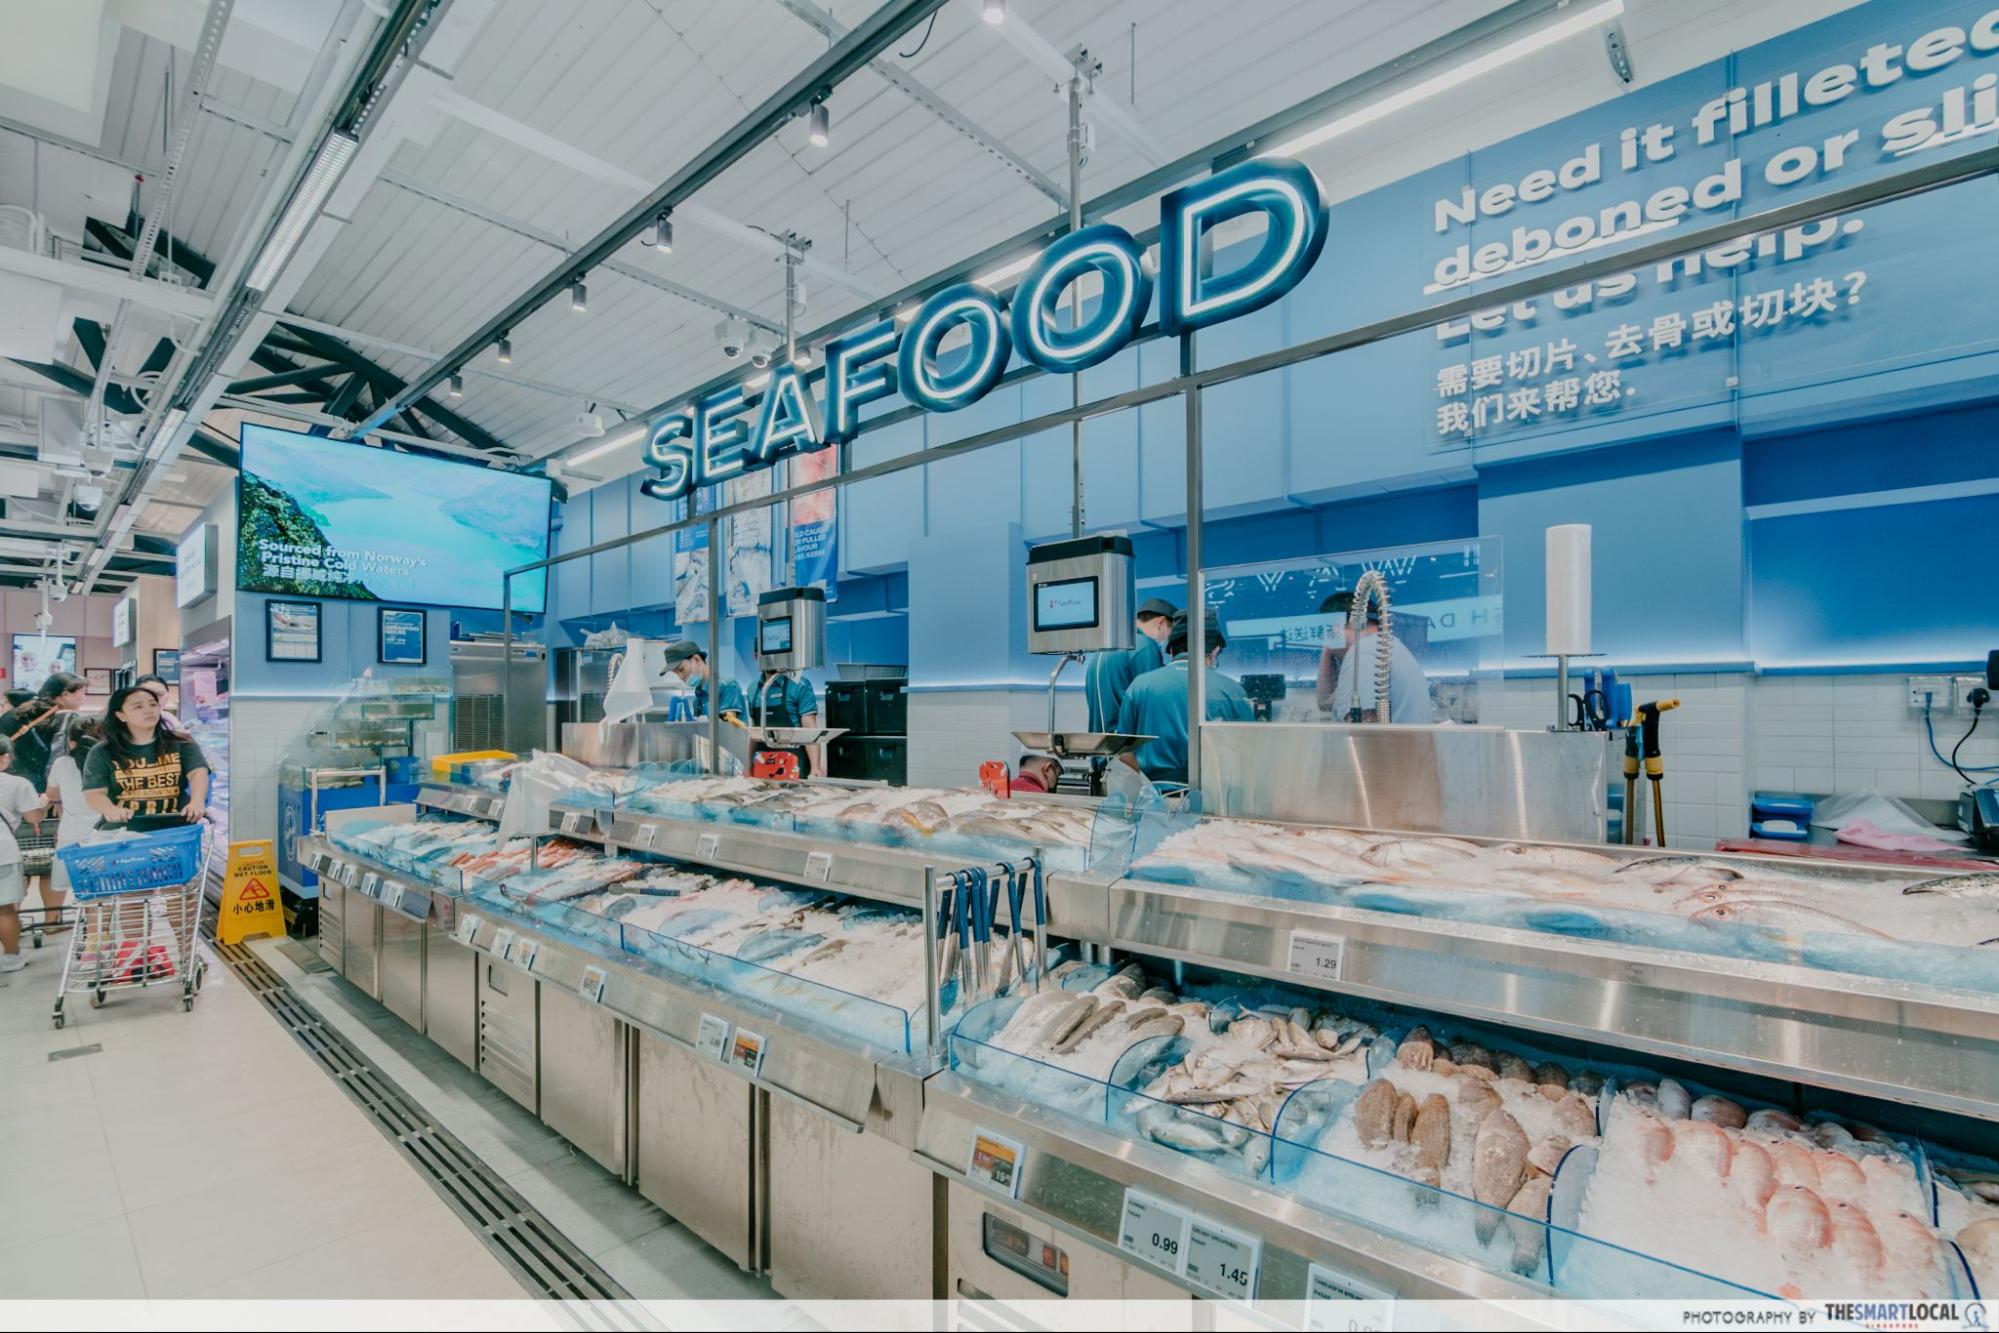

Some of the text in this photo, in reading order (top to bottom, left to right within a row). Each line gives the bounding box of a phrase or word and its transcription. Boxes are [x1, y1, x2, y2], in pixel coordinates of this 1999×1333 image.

[1433, 73, 1999, 286] deboned or sli
[1435, 144, 1601, 233] Need
[1620, 123, 1675, 171] it
[641, 157, 1330, 501] SEAFOOD
[1436, 270, 1867, 398] 需要切片、去骨或切块?
[259, 538, 428, 568] Sourced from Norway's
[262, 551, 409, 576] Pristine Cold Waters
[147, 772, 181, 788] BEST
[238, 864, 268, 872] CAUTION
[233, 898, 275, 915] 小心地滑
[1316, 957, 1337, 969] 1.29
[1152, 1232, 1178, 1255] 0.99
[1220, 1263, 1248, 1286] 1.45
